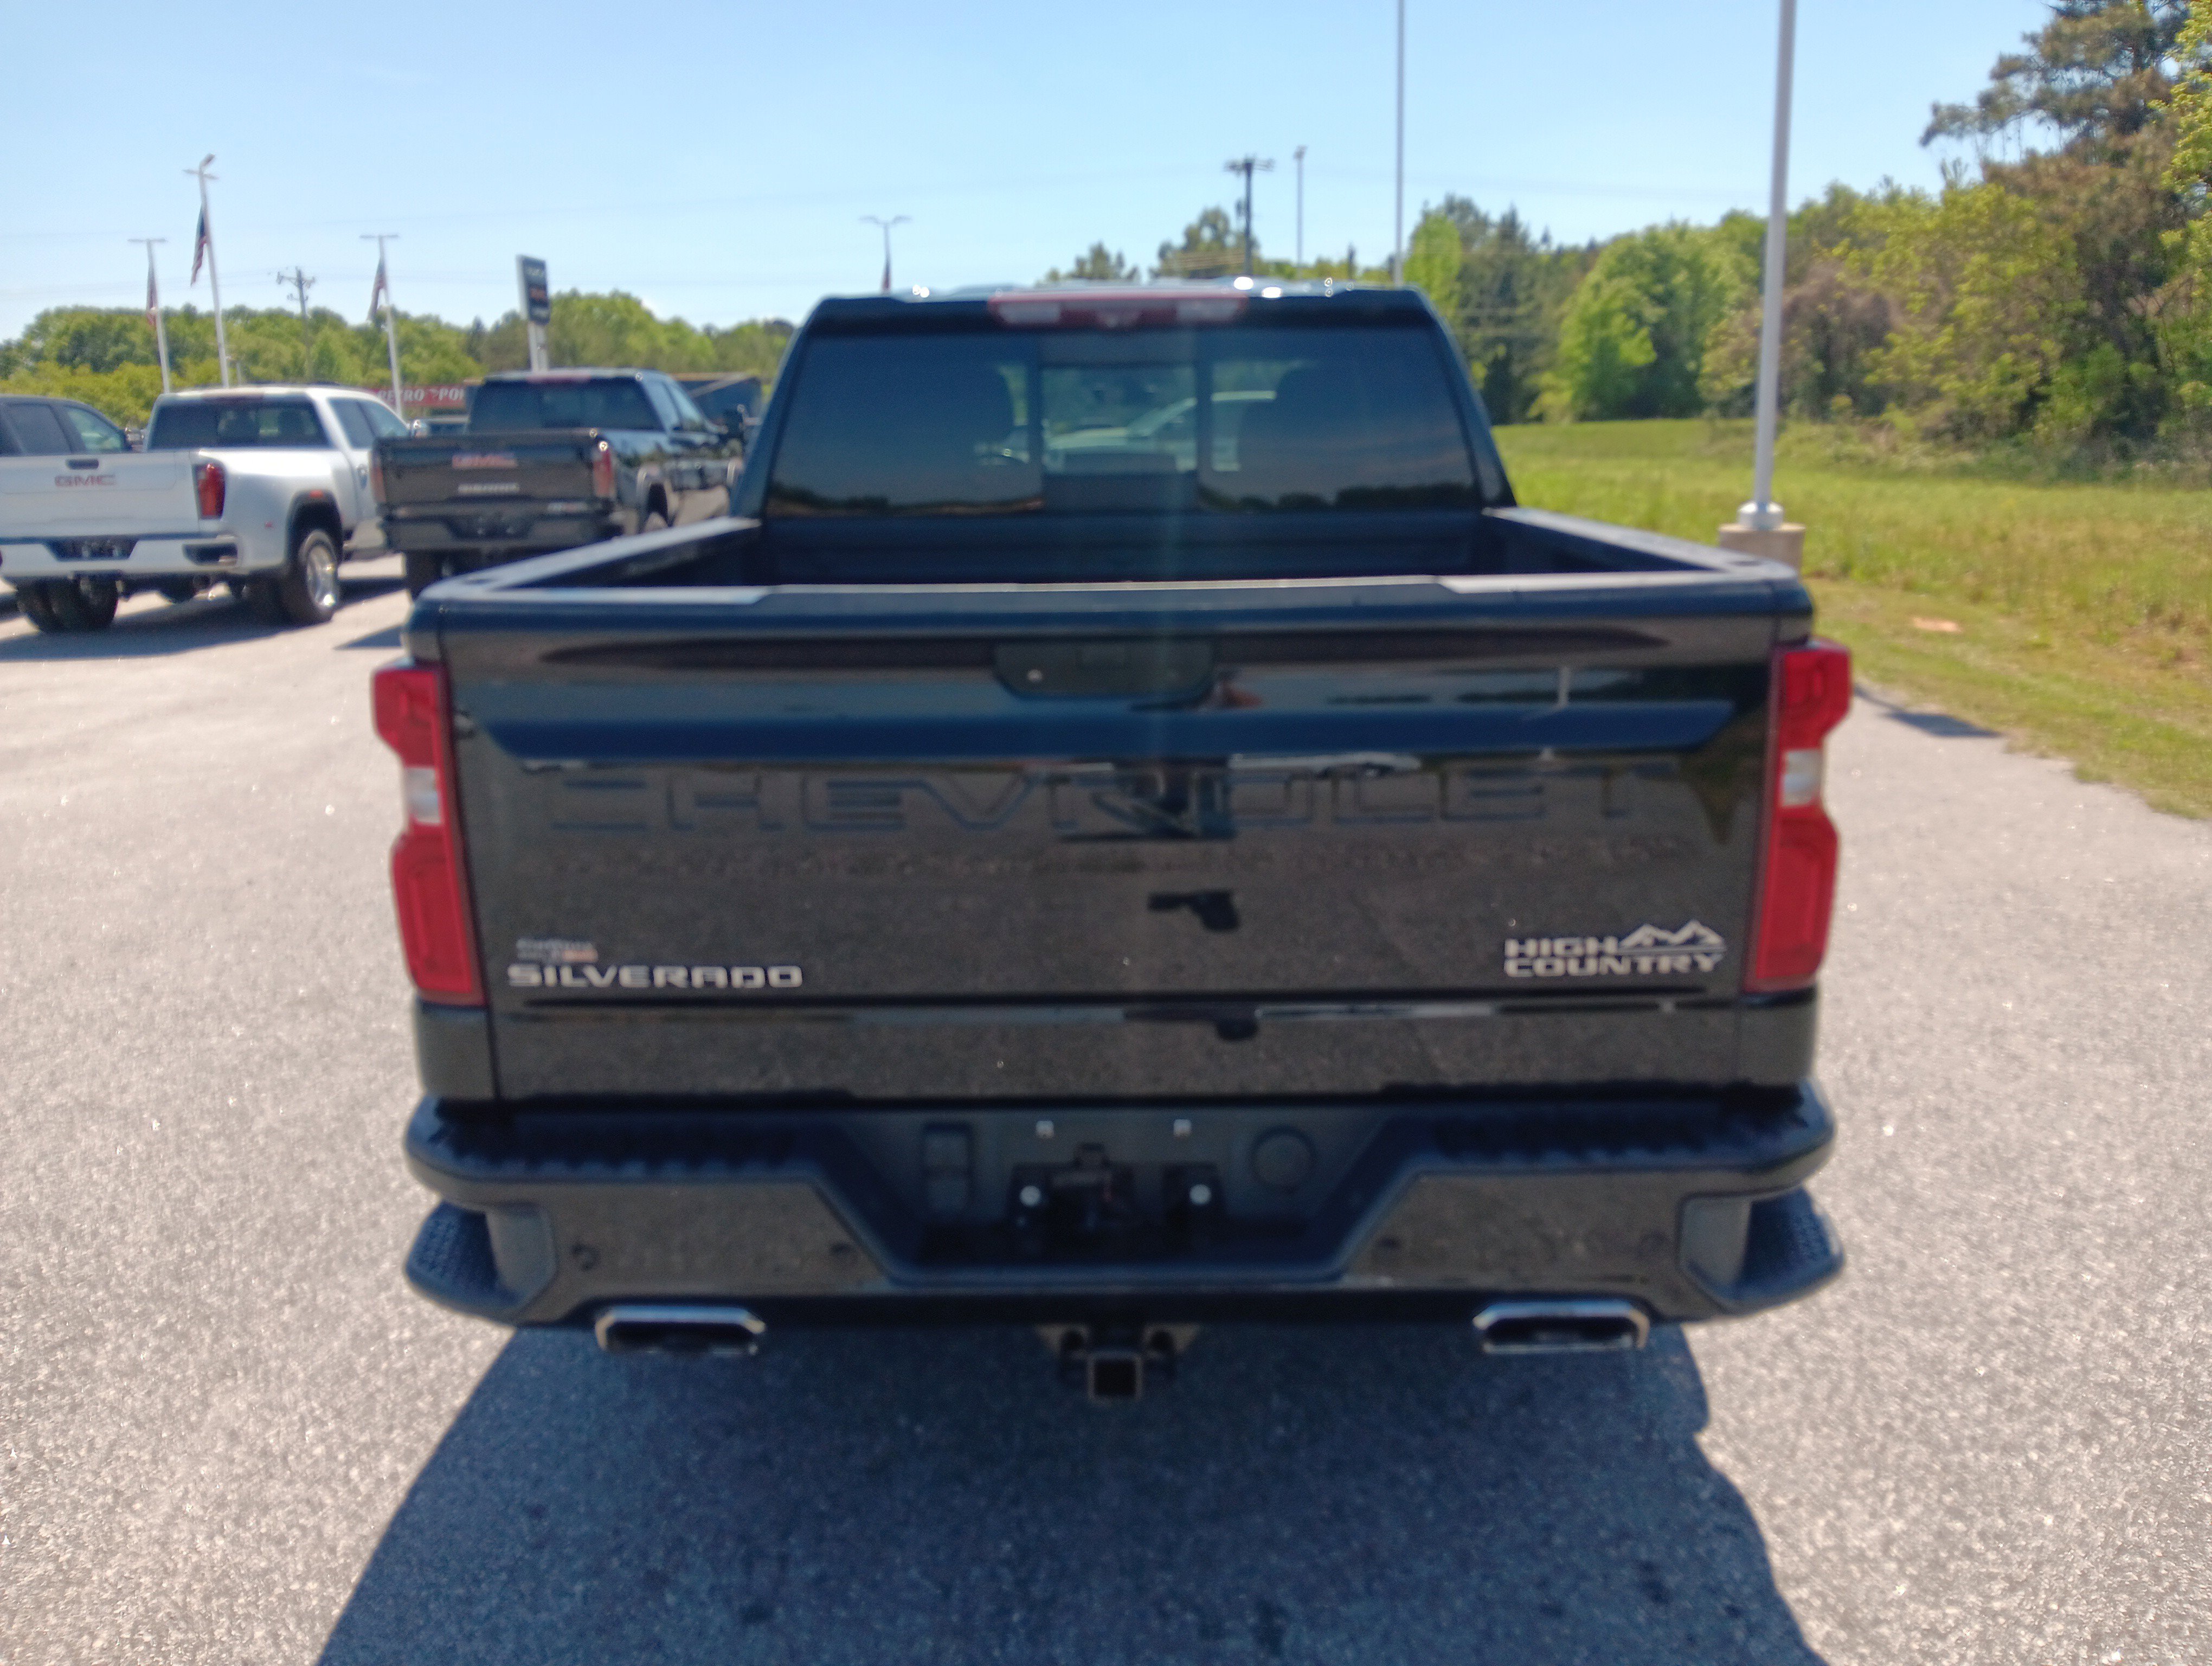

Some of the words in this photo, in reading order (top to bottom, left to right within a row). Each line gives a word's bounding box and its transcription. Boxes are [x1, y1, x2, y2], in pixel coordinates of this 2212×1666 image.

[54, 475, 116, 486] GMC
[1504, 937, 1619, 957] HIGH
[507, 964, 803, 988] SILVERADO
[1504, 953, 1723, 977] COUNTRY
